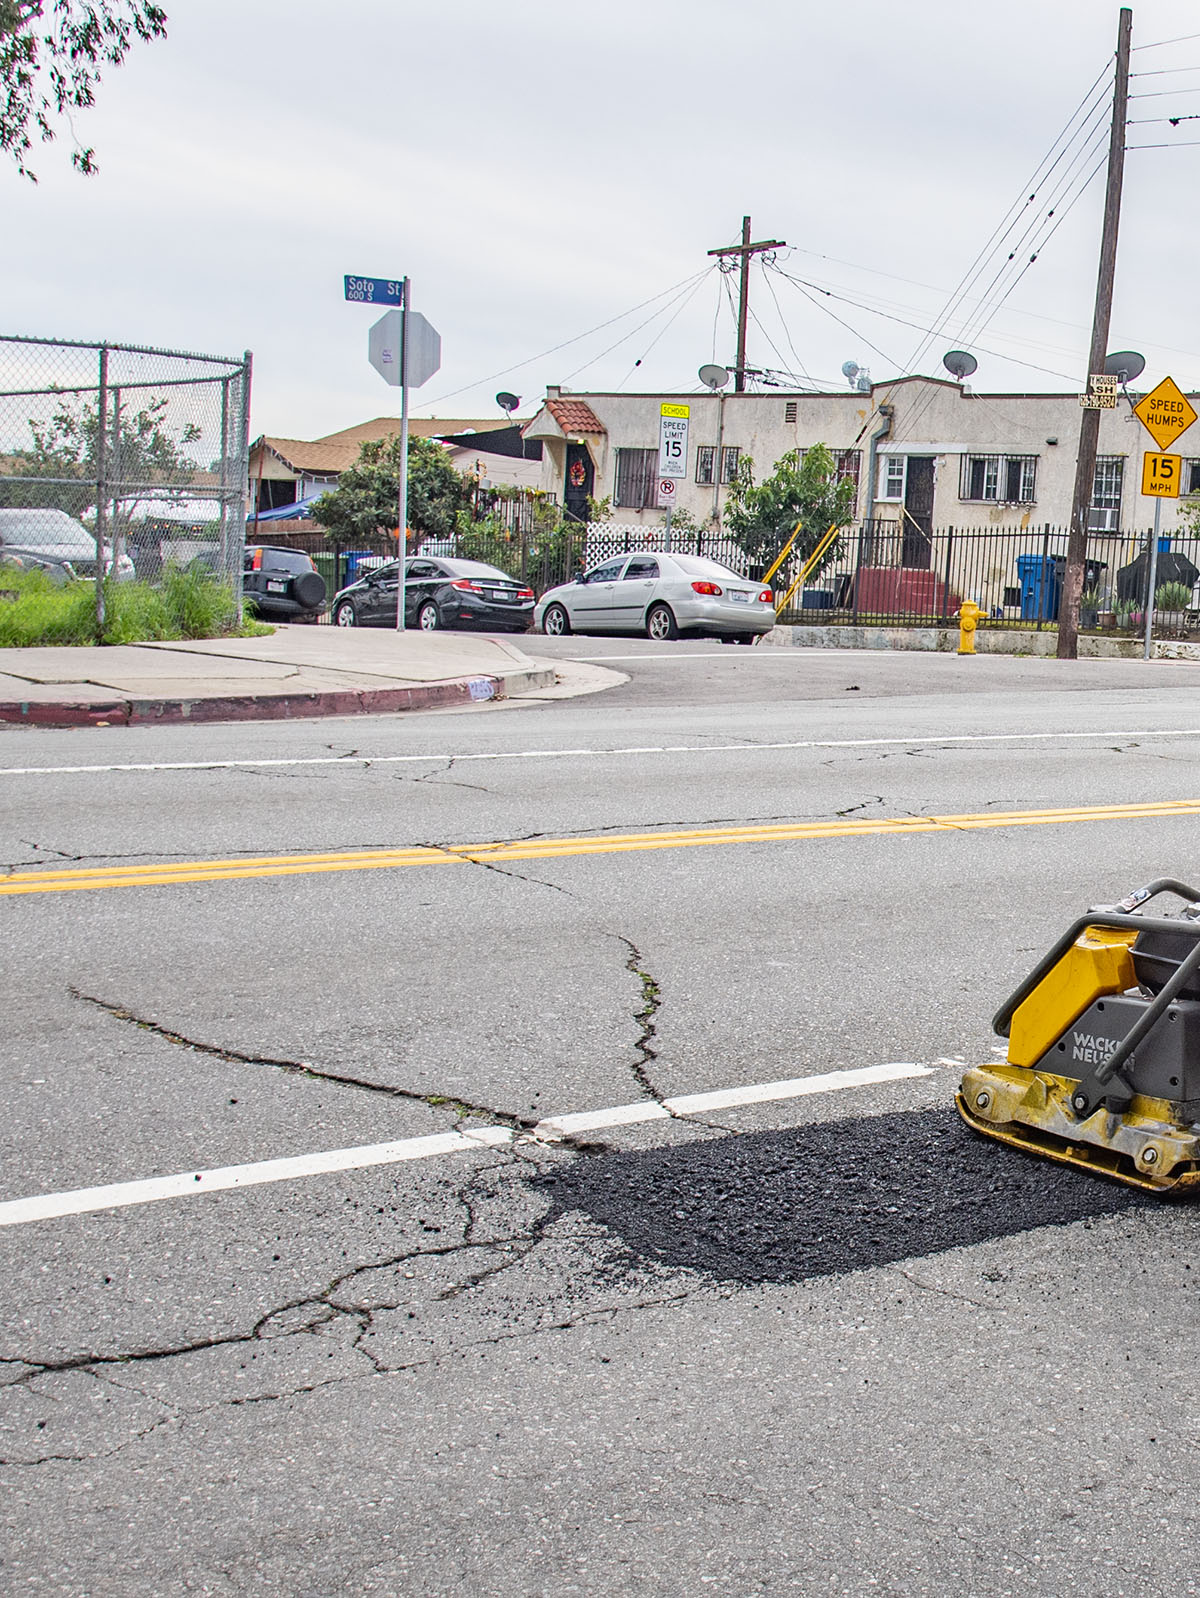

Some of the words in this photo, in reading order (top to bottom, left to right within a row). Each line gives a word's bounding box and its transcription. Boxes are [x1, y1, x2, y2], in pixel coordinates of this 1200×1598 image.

[348, 277, 375, 292] Soto
[387, 282, 401, 296] St
[348, 290, 364, 300] 600
[367, 292, 373, 301] S
[1096, 376, 1117, 385] HOUSES
[663, 406, 687, 416] SCHOOL
[1150, 399, 1184, 413] SPEED
[663, 421, 687, 431] SPEED
[1146, 413, 1185, 428] HUMPS
[664, 431, 684, 439] LIMIT
[665, 440, 682, 457] 15
[1152, 458, 1173, 478] 15
[1149, 482, 1172, 493] MPH
[1073, 1031, 1122, 1053] WACK
[1072, 1046, 1136, 1073] NEUSN
